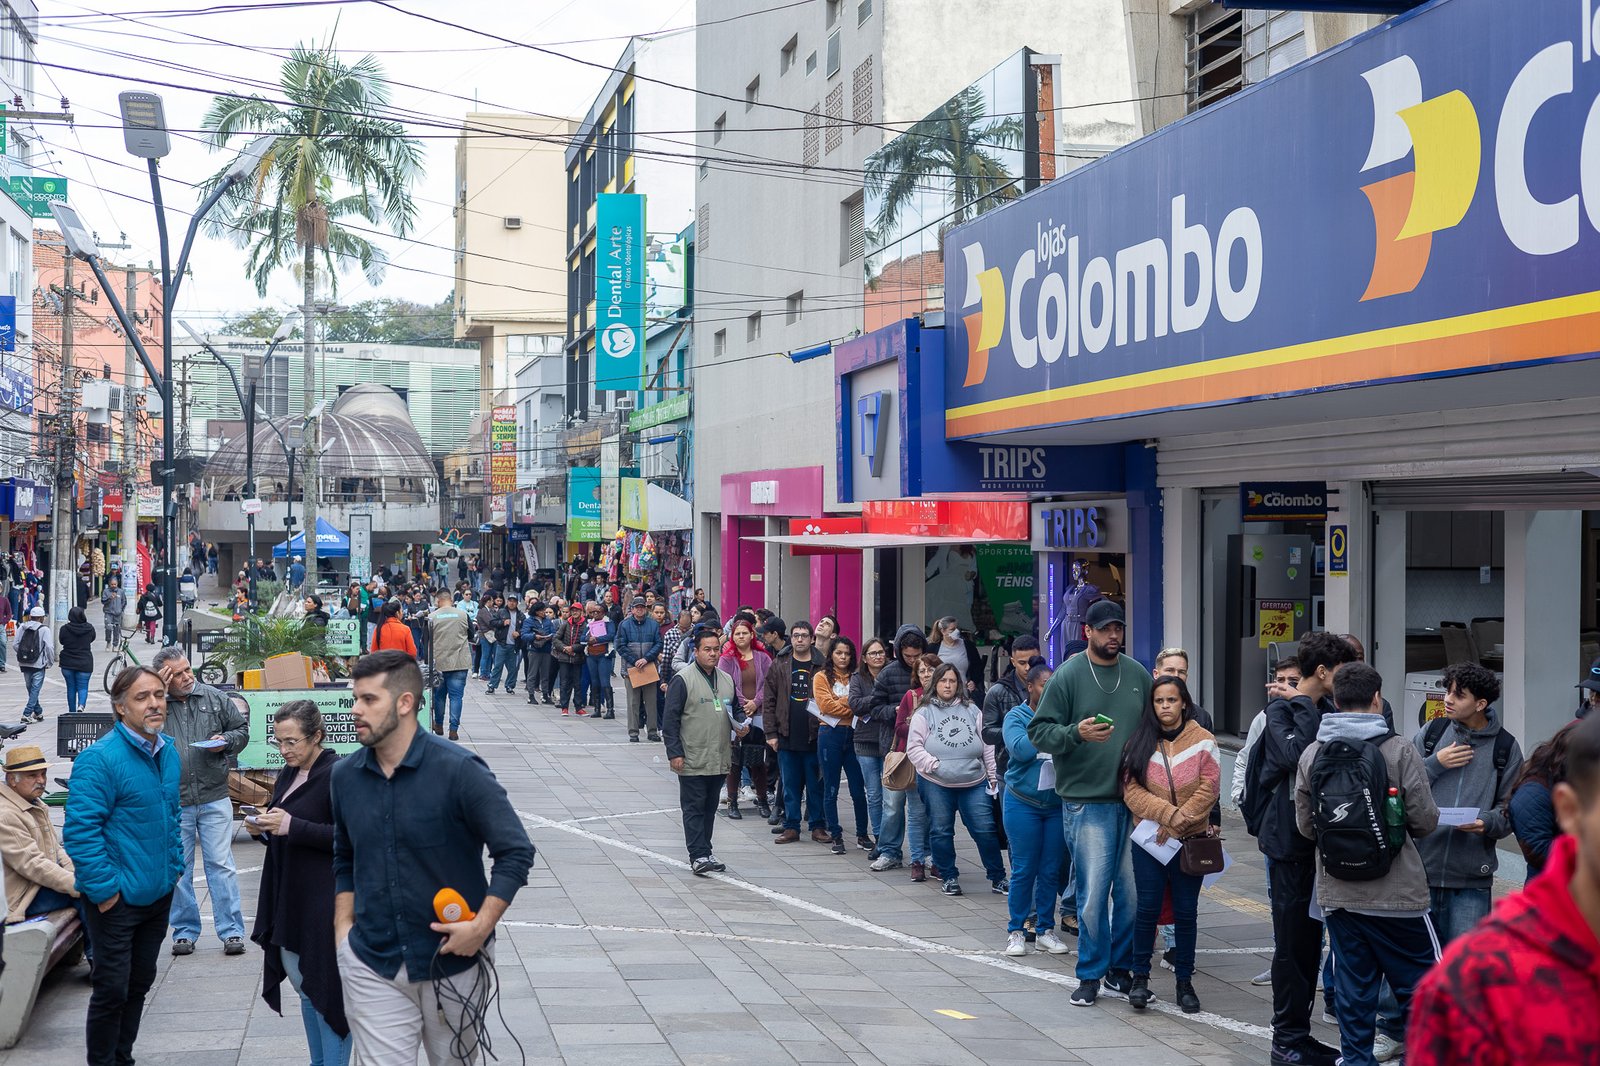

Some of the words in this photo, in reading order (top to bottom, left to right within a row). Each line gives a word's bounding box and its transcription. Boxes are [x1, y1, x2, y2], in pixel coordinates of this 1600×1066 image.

[609, 226, 622, 260] Arte
[625, 226, 633, 266] Odontológicas
[1037, 218, 1066, 268] lojas
[607, 265, 622, 318] Dental
[1009, 194, 1263, 369] Colombo
[272, 345, 304, 353] ANOAS
[979, 448, 1046, 479] TRIPS
[1263, 493, 1323, 507] Colombo
[1041, 506, 1099, 548] TRIPS
[995, 573, 1034, 588] TÊNIS
[338, 698, 357, 709] PRO
[1362, 788, 1376, 821] SPIRIT
[1371, 822, 1386, 849] SPORTS
